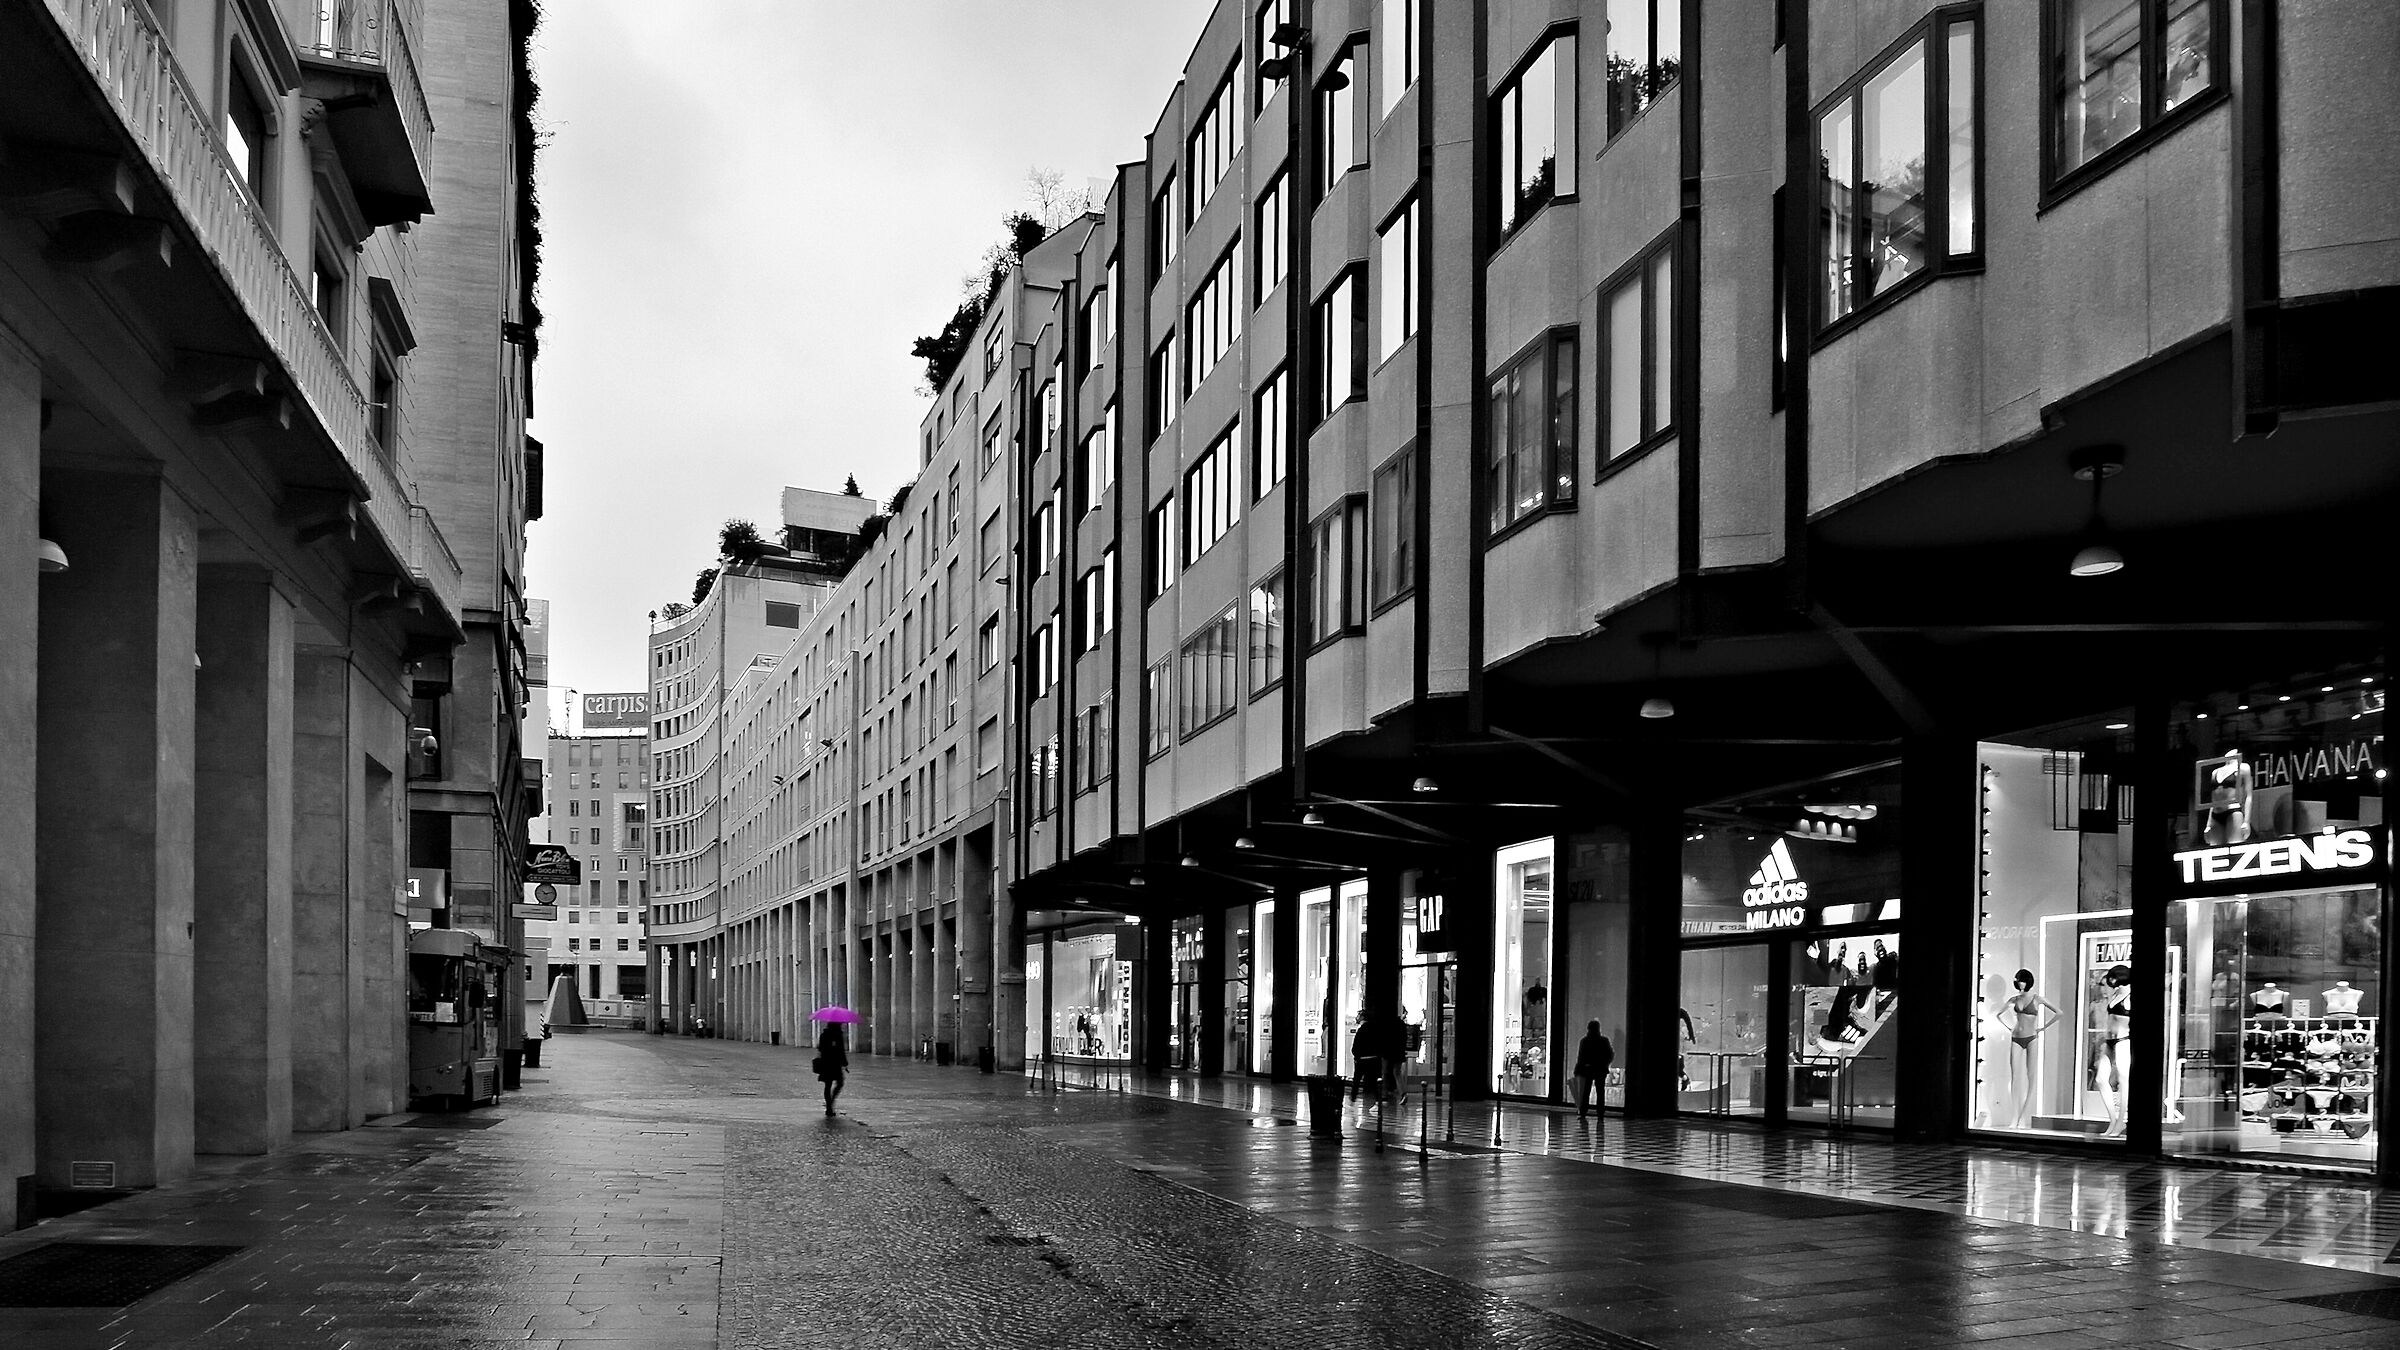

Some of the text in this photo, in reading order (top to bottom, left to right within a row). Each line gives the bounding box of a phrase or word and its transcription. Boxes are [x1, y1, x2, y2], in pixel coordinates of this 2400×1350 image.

[2254, 742, 2374, 788] HAVANA
[1742, 880, 1808, 907] adidas
[1419, 895, 1443, 933] GAP
[1746, 907, 1806, 930] MILANO
